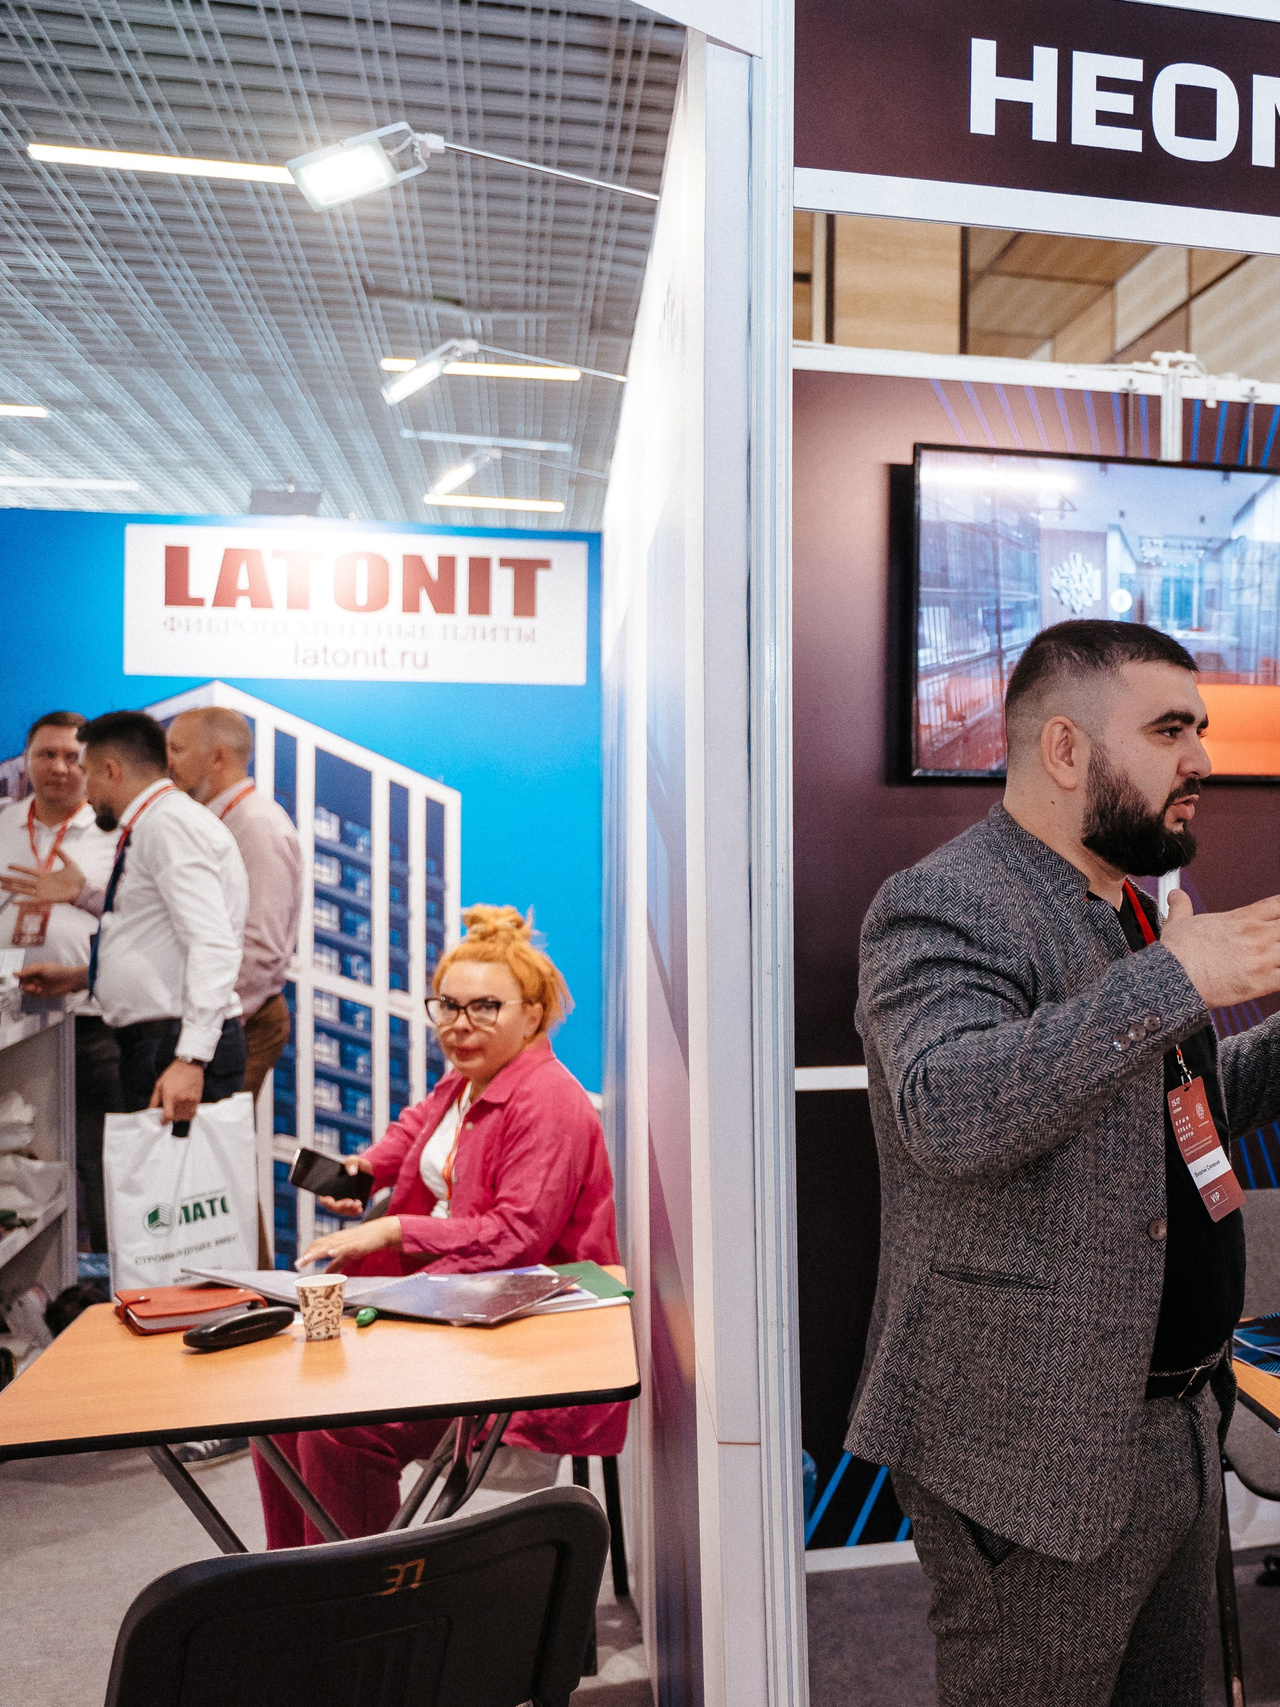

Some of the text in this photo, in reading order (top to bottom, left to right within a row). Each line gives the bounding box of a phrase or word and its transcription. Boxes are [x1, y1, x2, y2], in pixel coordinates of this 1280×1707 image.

[164, 544, 552, 618] LATONIT
[163, 616, 537, 643] ФИБРОЦЕМЕНТНЫЕ ПЛИТЫ
[294, 641, 429, 671] latonit.ru
[1210, 1191, 1220, 1203] VIP
[381, 1558, 426, 1596] 37
